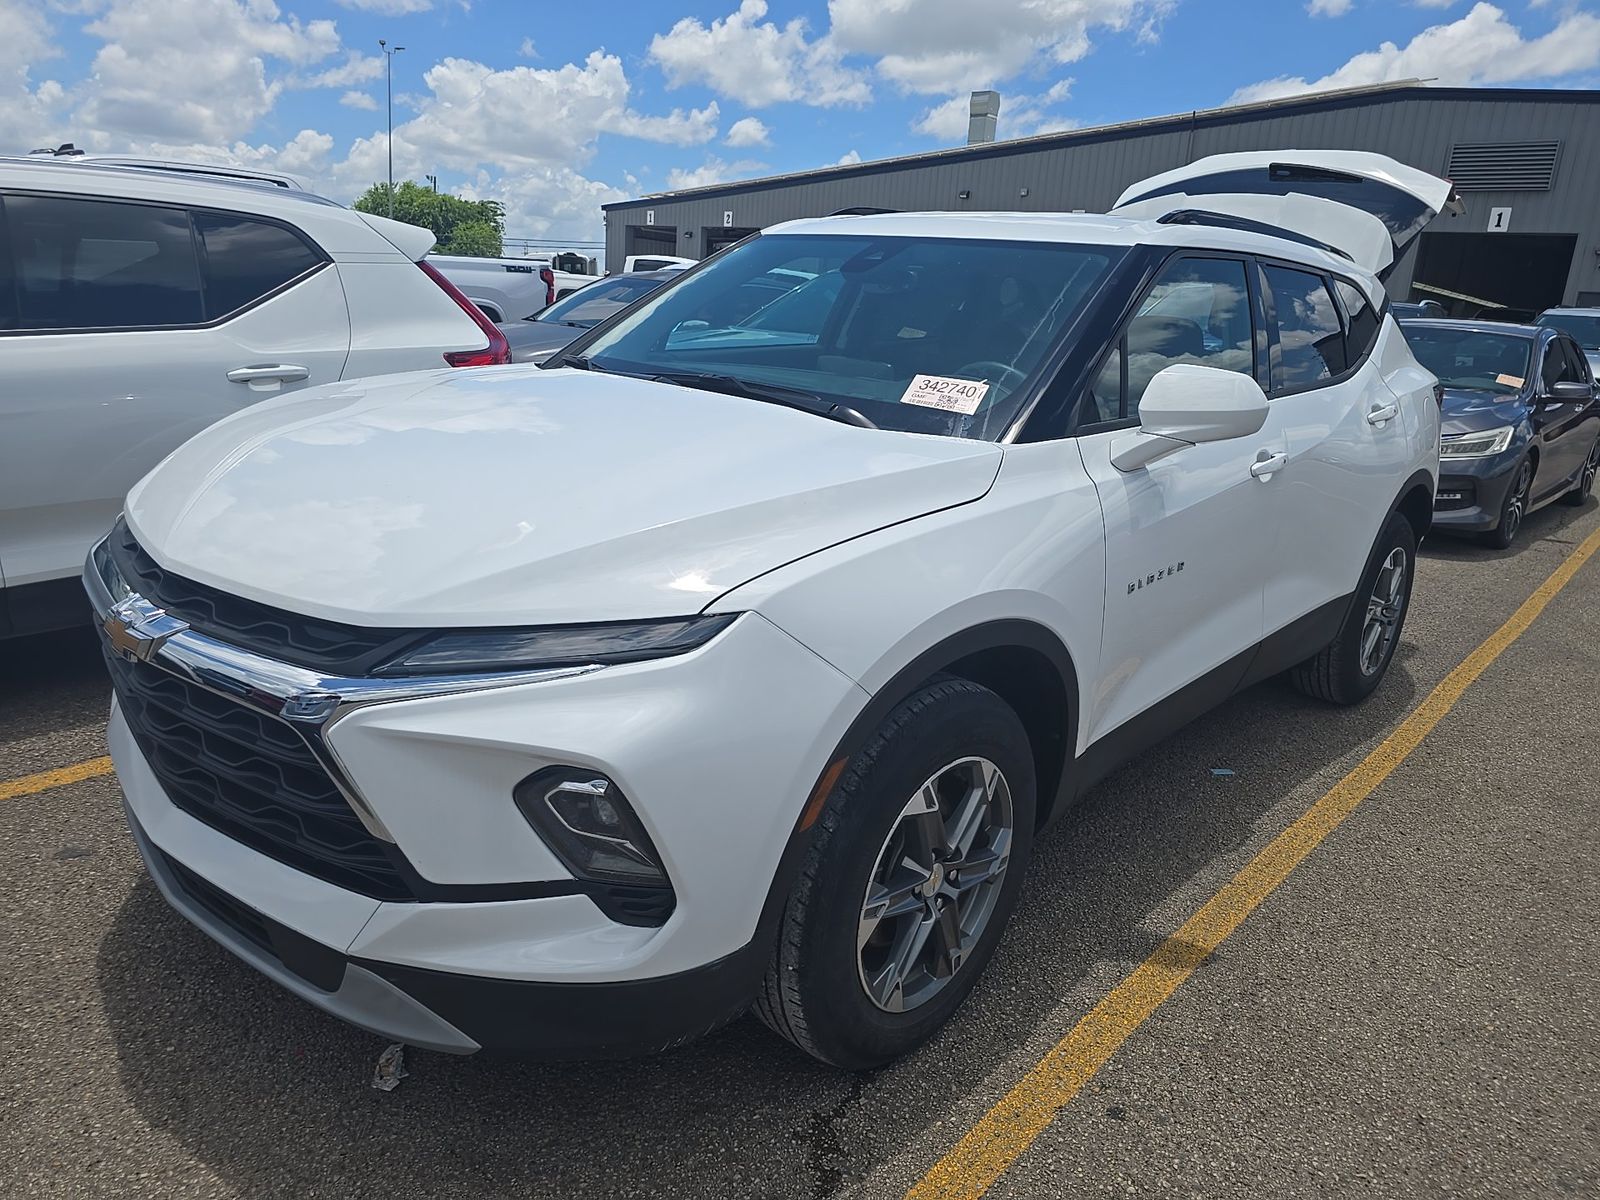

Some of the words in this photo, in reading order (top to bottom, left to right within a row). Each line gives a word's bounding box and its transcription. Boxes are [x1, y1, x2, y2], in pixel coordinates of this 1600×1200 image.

[648, 213, 653, 223] 1
[725, 213, 731, 224] 2
[1494, 212, 1503, 228] 1
[918, 379, 977, 398] 342740
[1127, 561, 1185, 595] BLAZER
